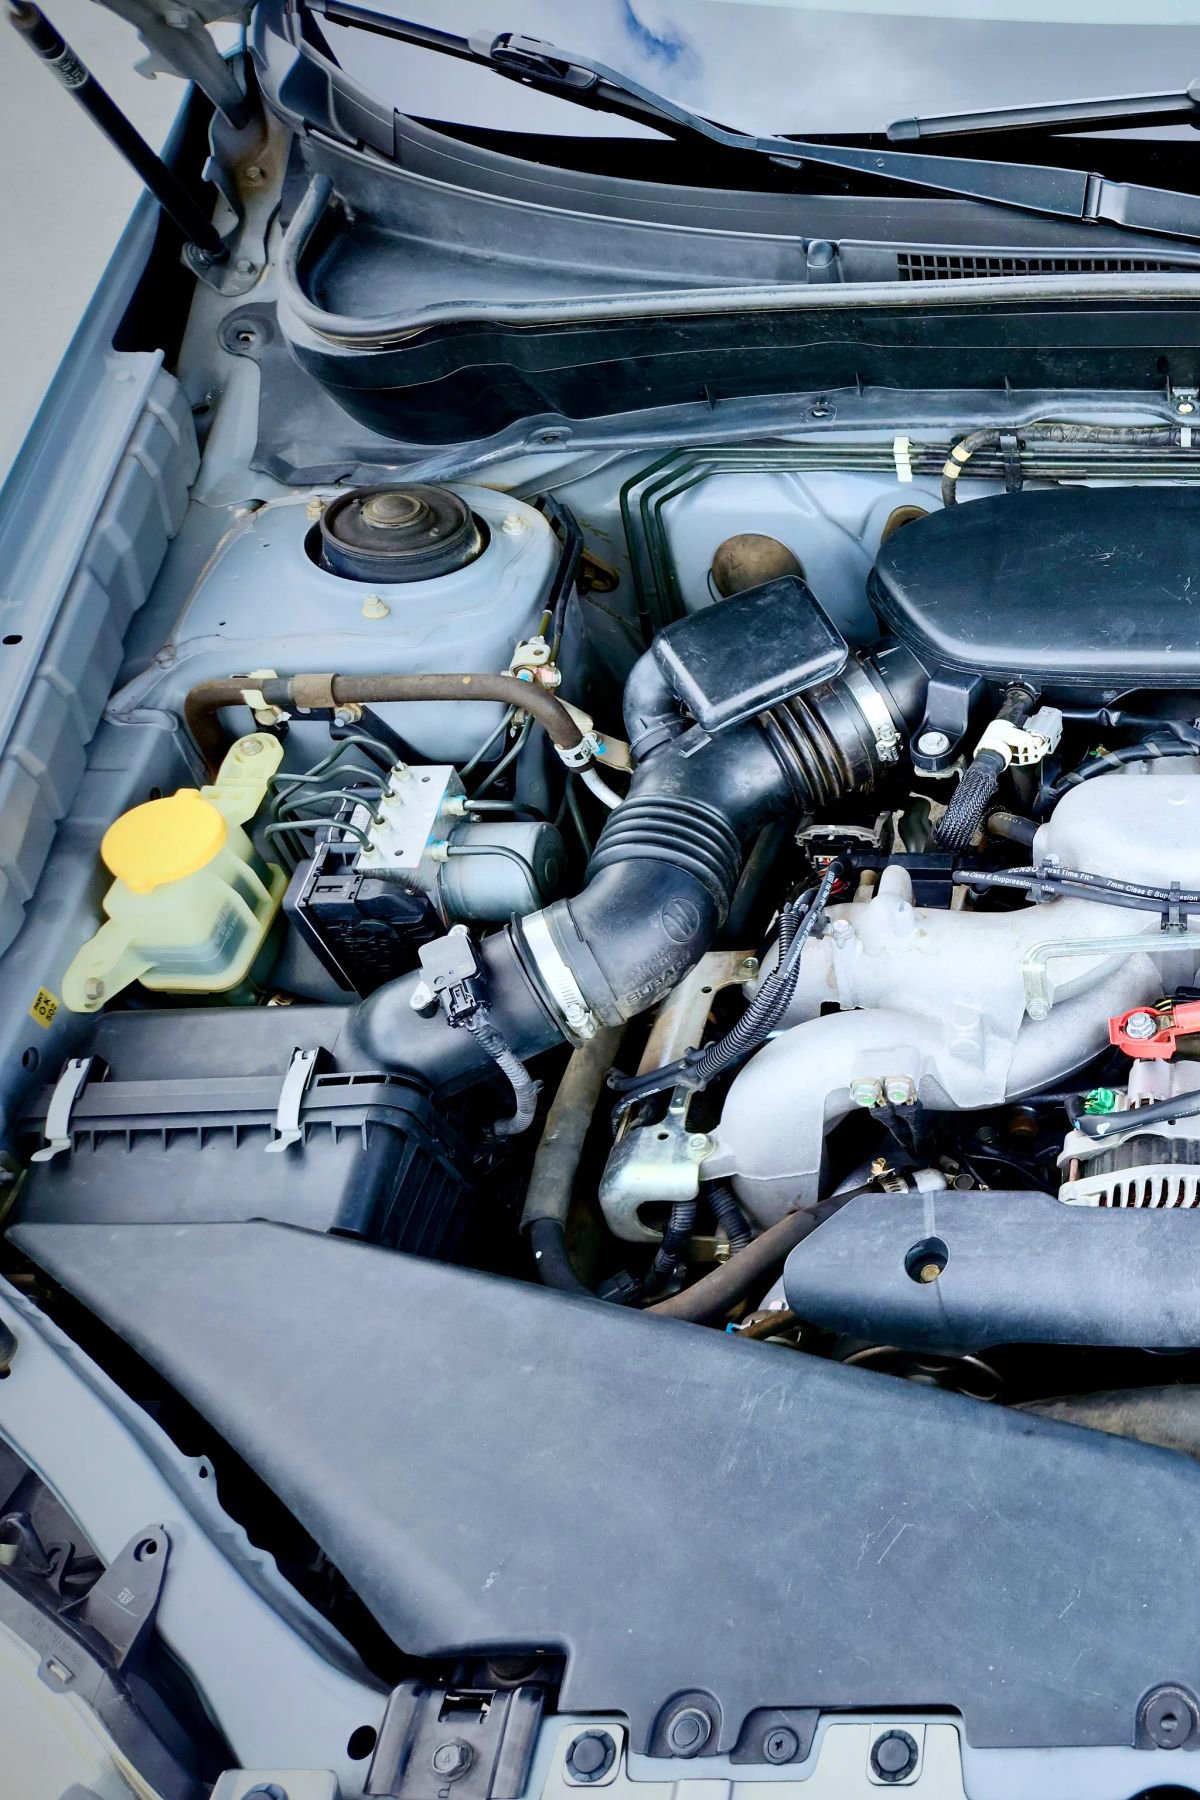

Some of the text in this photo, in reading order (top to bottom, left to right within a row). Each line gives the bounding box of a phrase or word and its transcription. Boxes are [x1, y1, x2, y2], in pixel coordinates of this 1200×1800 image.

[1007, 864, 1038, 875] DENSO
[1061, 869, 1078, 877] Time
[1106, 879, 1124, 889] 7mm
[1125, 884, 1145, 894] Class
